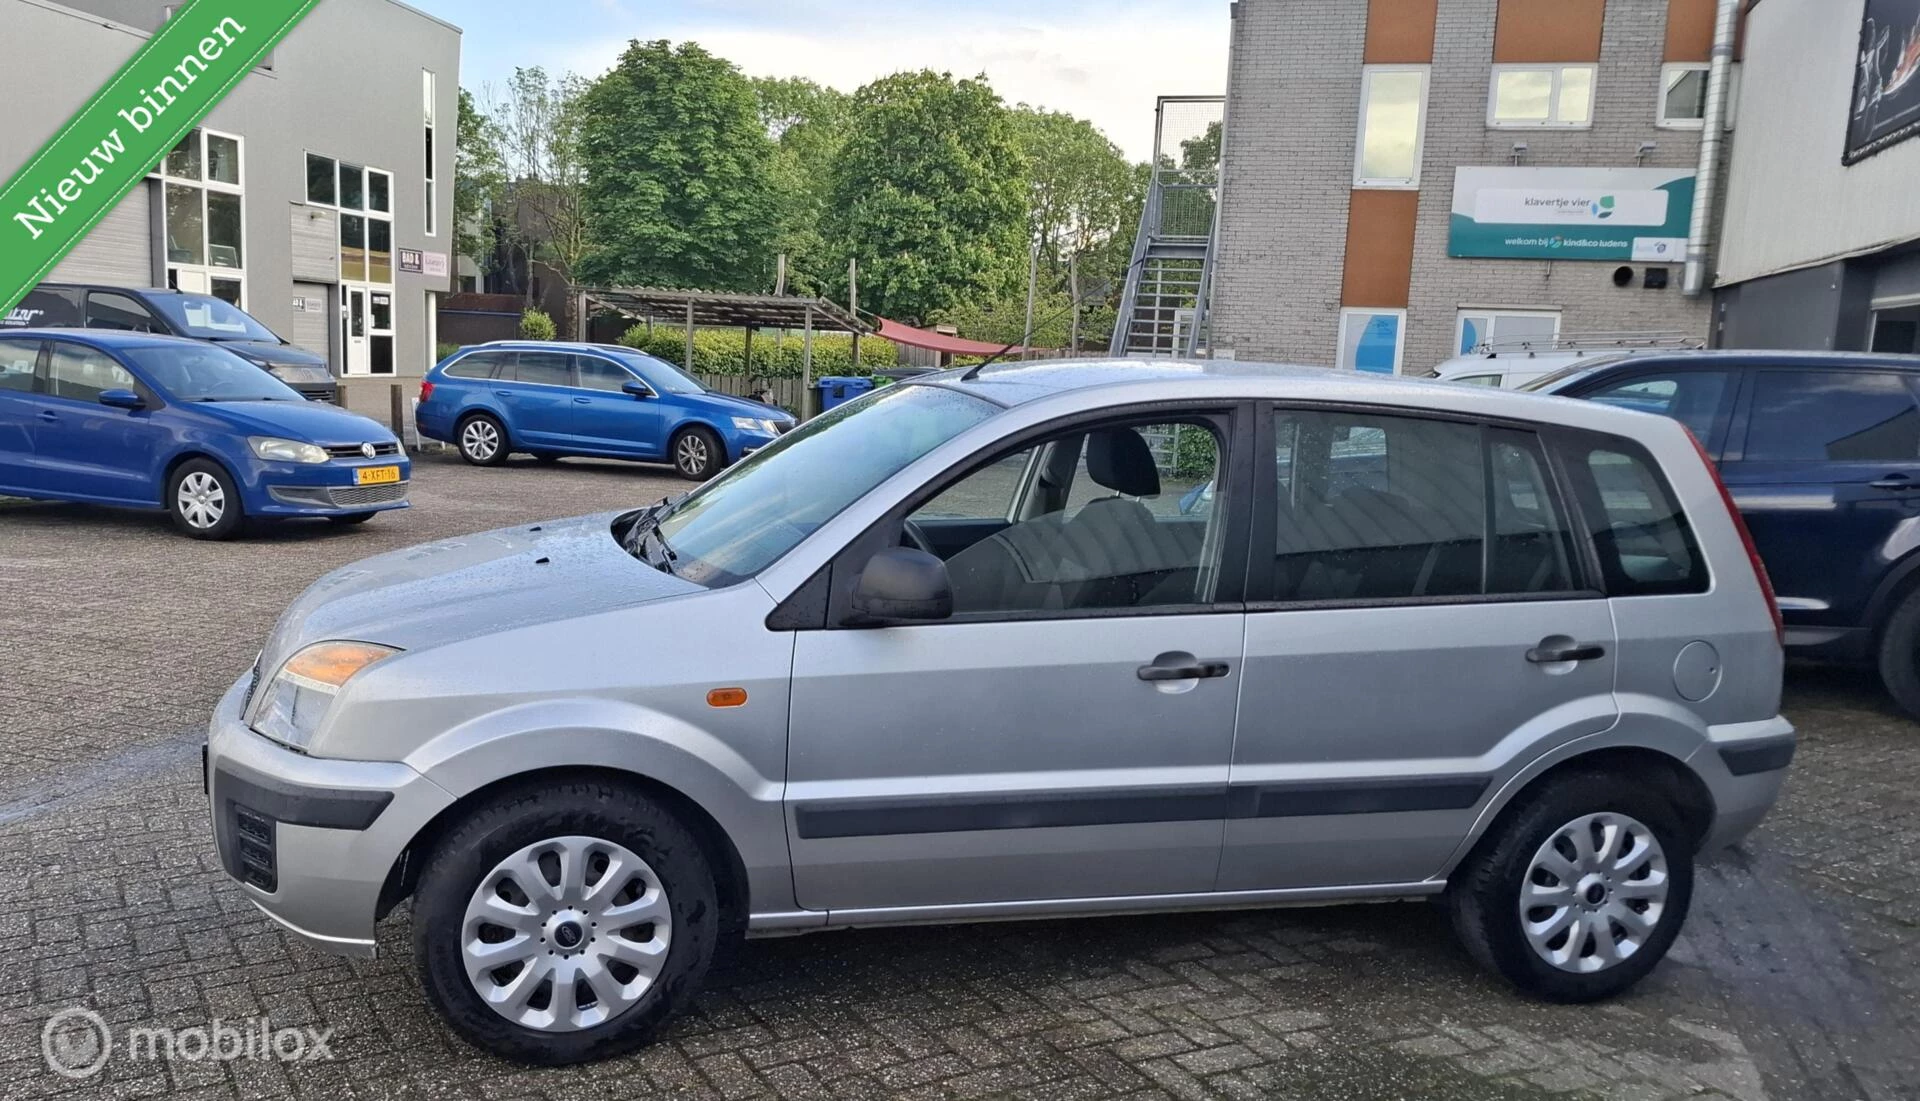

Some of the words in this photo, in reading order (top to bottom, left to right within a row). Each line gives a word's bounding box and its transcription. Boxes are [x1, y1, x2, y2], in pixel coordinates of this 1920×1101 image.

[1524, 197, 1569, 208] klavertje
[1571, 198, 1591, 206] vier
[1504, 237, 1537, 246] welkom
[1538, 237, 1549, 248] bij
[362, 469, 396, 481] 4-XFT-16
